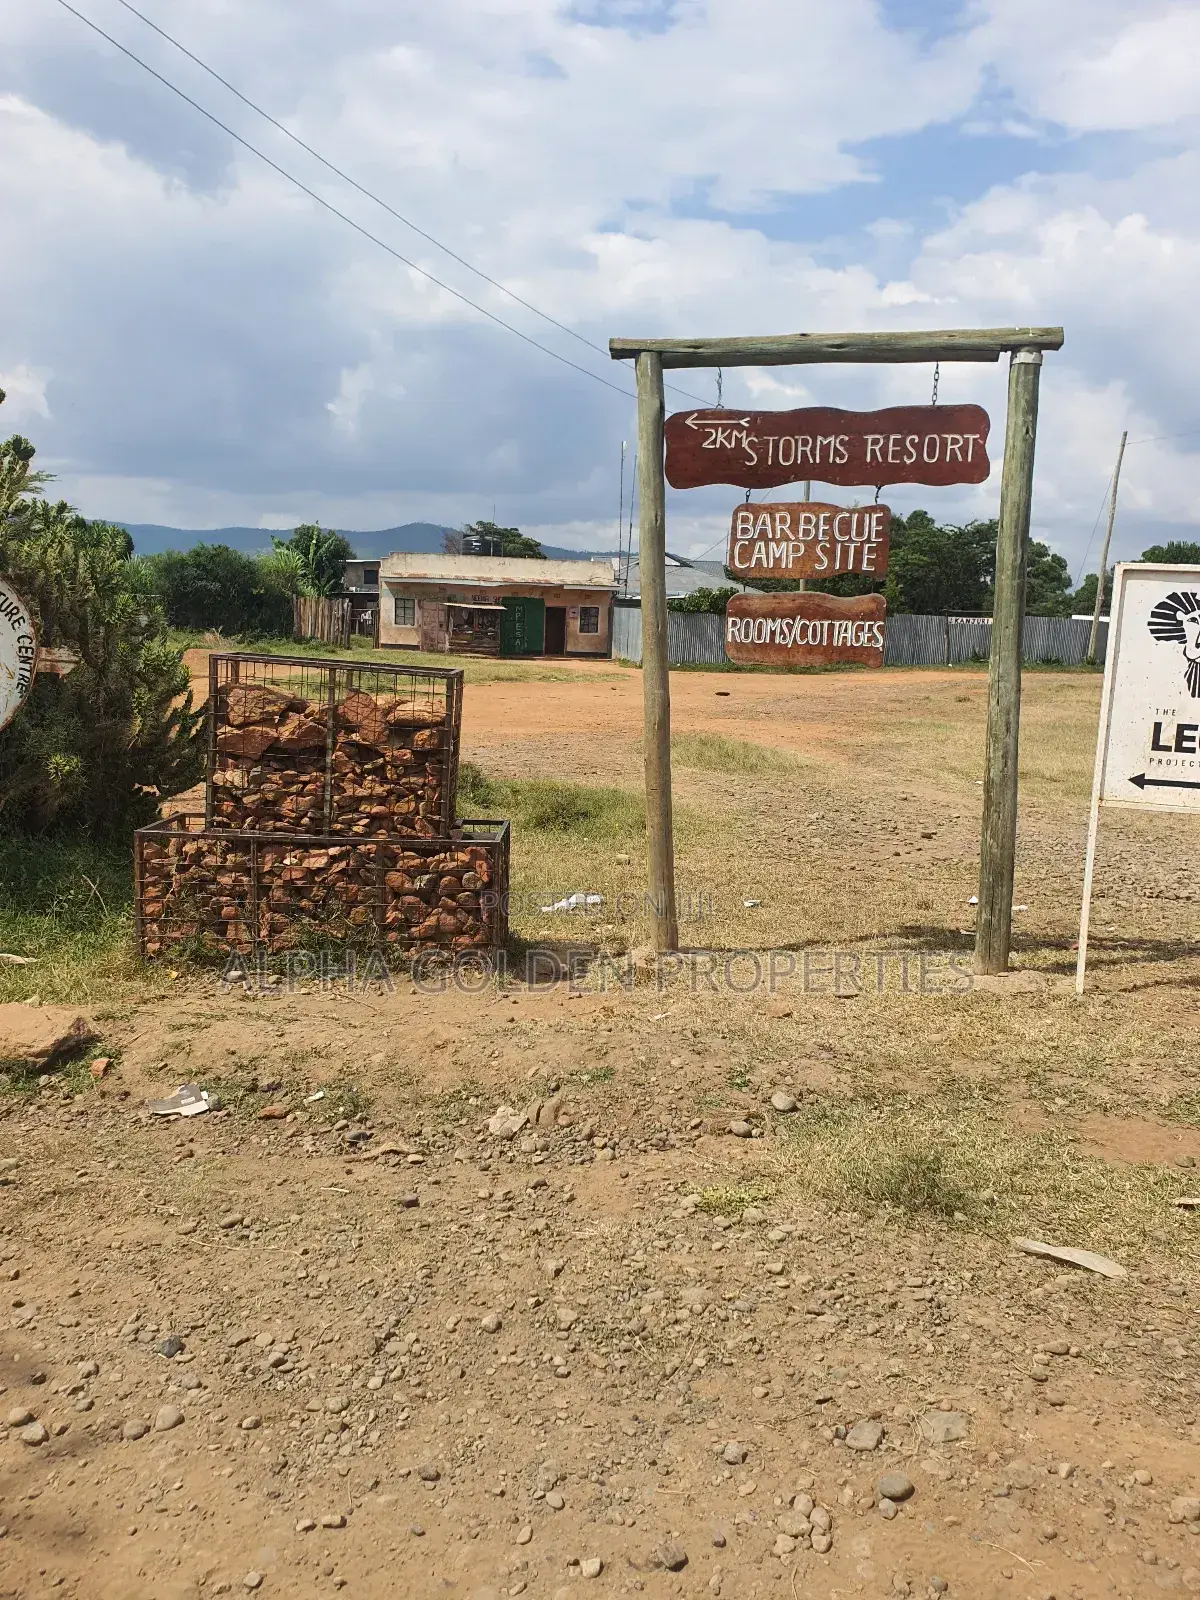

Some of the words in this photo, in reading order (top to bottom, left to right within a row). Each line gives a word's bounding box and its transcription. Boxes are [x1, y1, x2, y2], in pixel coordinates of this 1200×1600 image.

[701, 428, 746, 449] 2KM
[745, 434, 849, 466] STORMS
[864, 433, 980, 464] RESORT
[736, 511, 884, 542] BARBECUE
[733, 541, 805, 570] CAMP
[814, 542, 877, 571] SITE
[727, 617, 884, 649] ROOMS/COTTAGES
[1155, 708, 1177, 717] THE
[1151, 721, 1200, 754] LE
